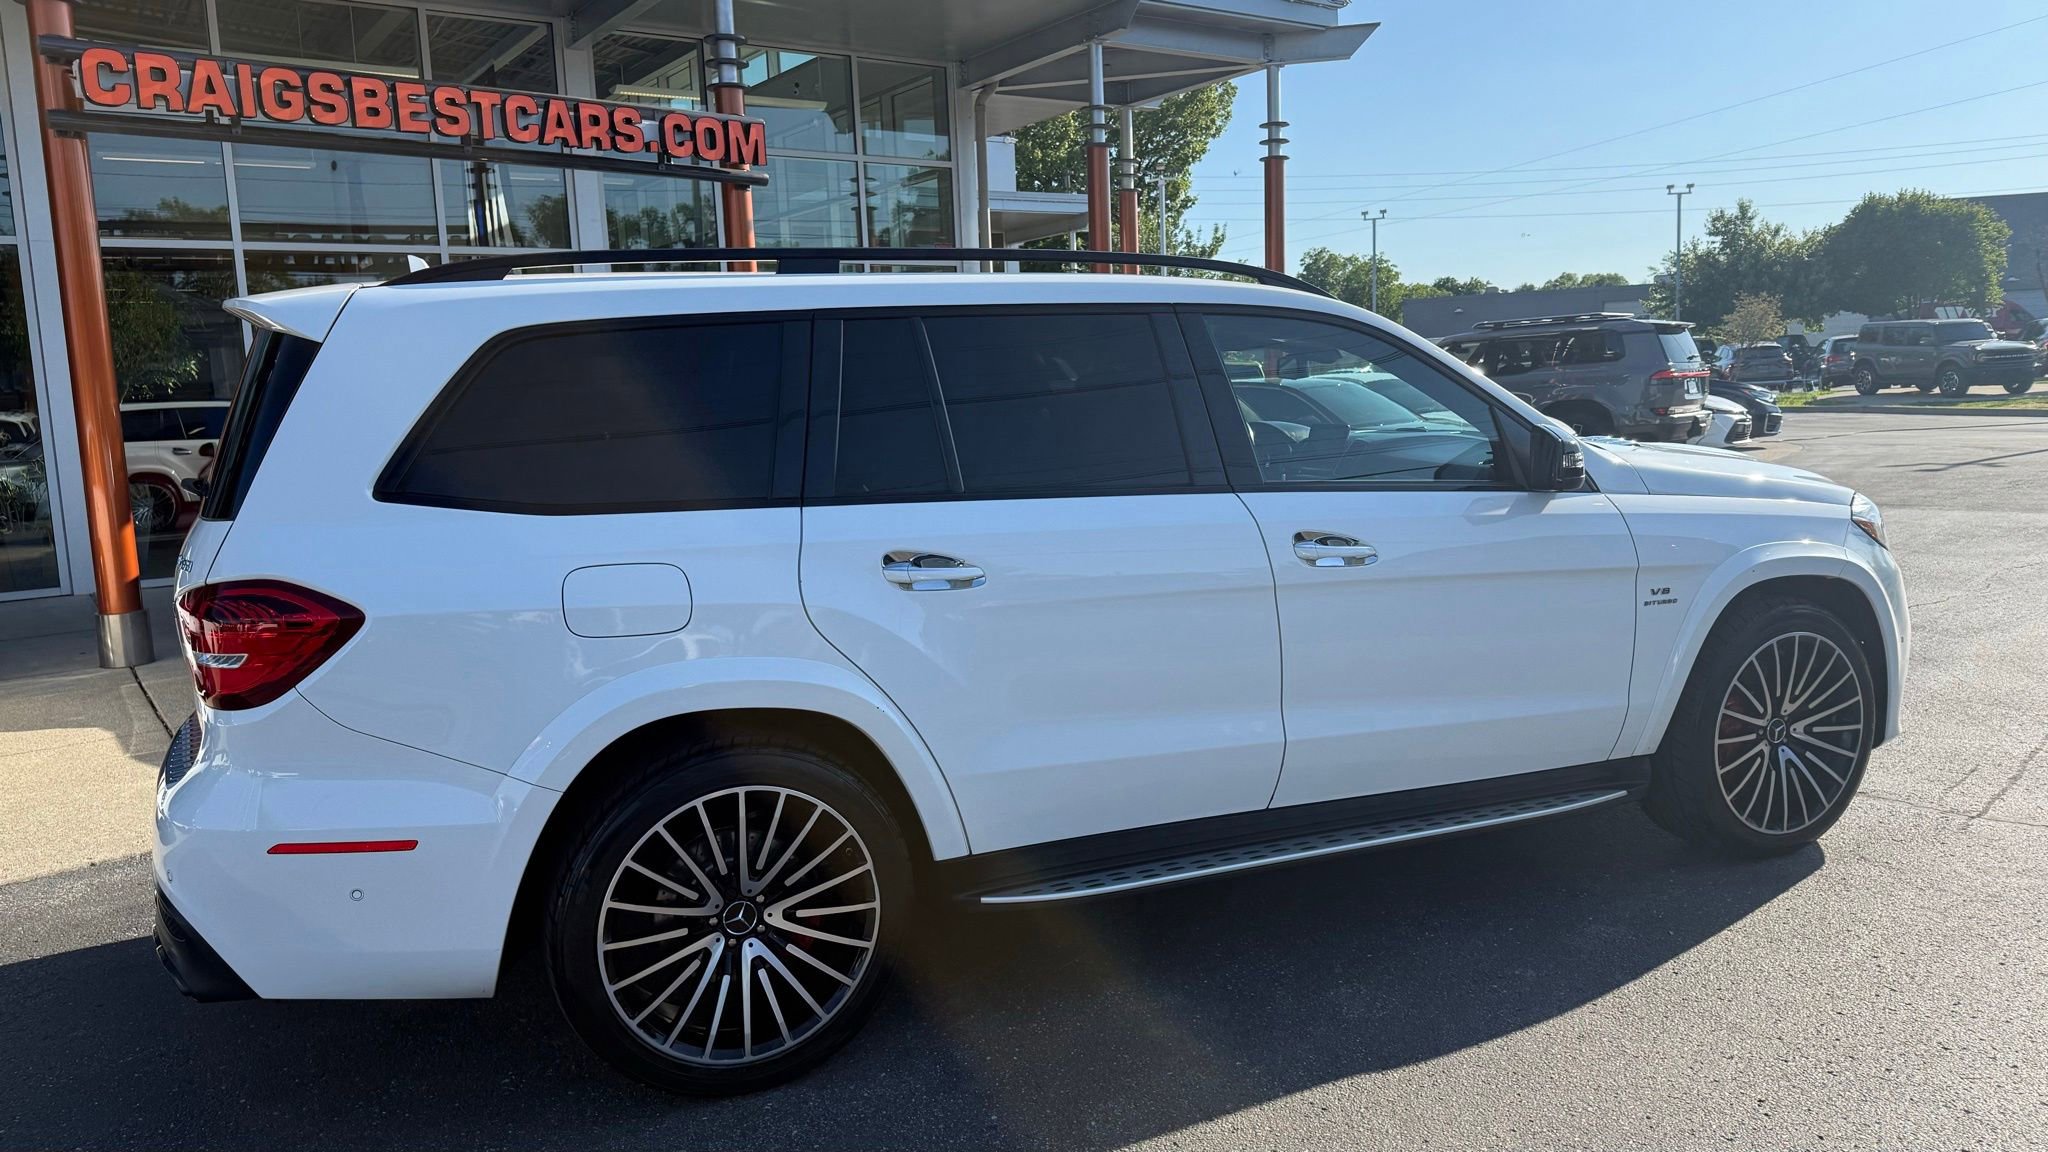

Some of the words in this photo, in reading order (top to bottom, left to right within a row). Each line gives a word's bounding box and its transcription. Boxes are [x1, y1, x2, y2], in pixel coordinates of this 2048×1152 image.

[79, 47, 768, 167] CRAIGSBESTCARS.COM
[1650, 587, 1671, 596] V8
[1643, 598, 1679, 607] BITURBO
